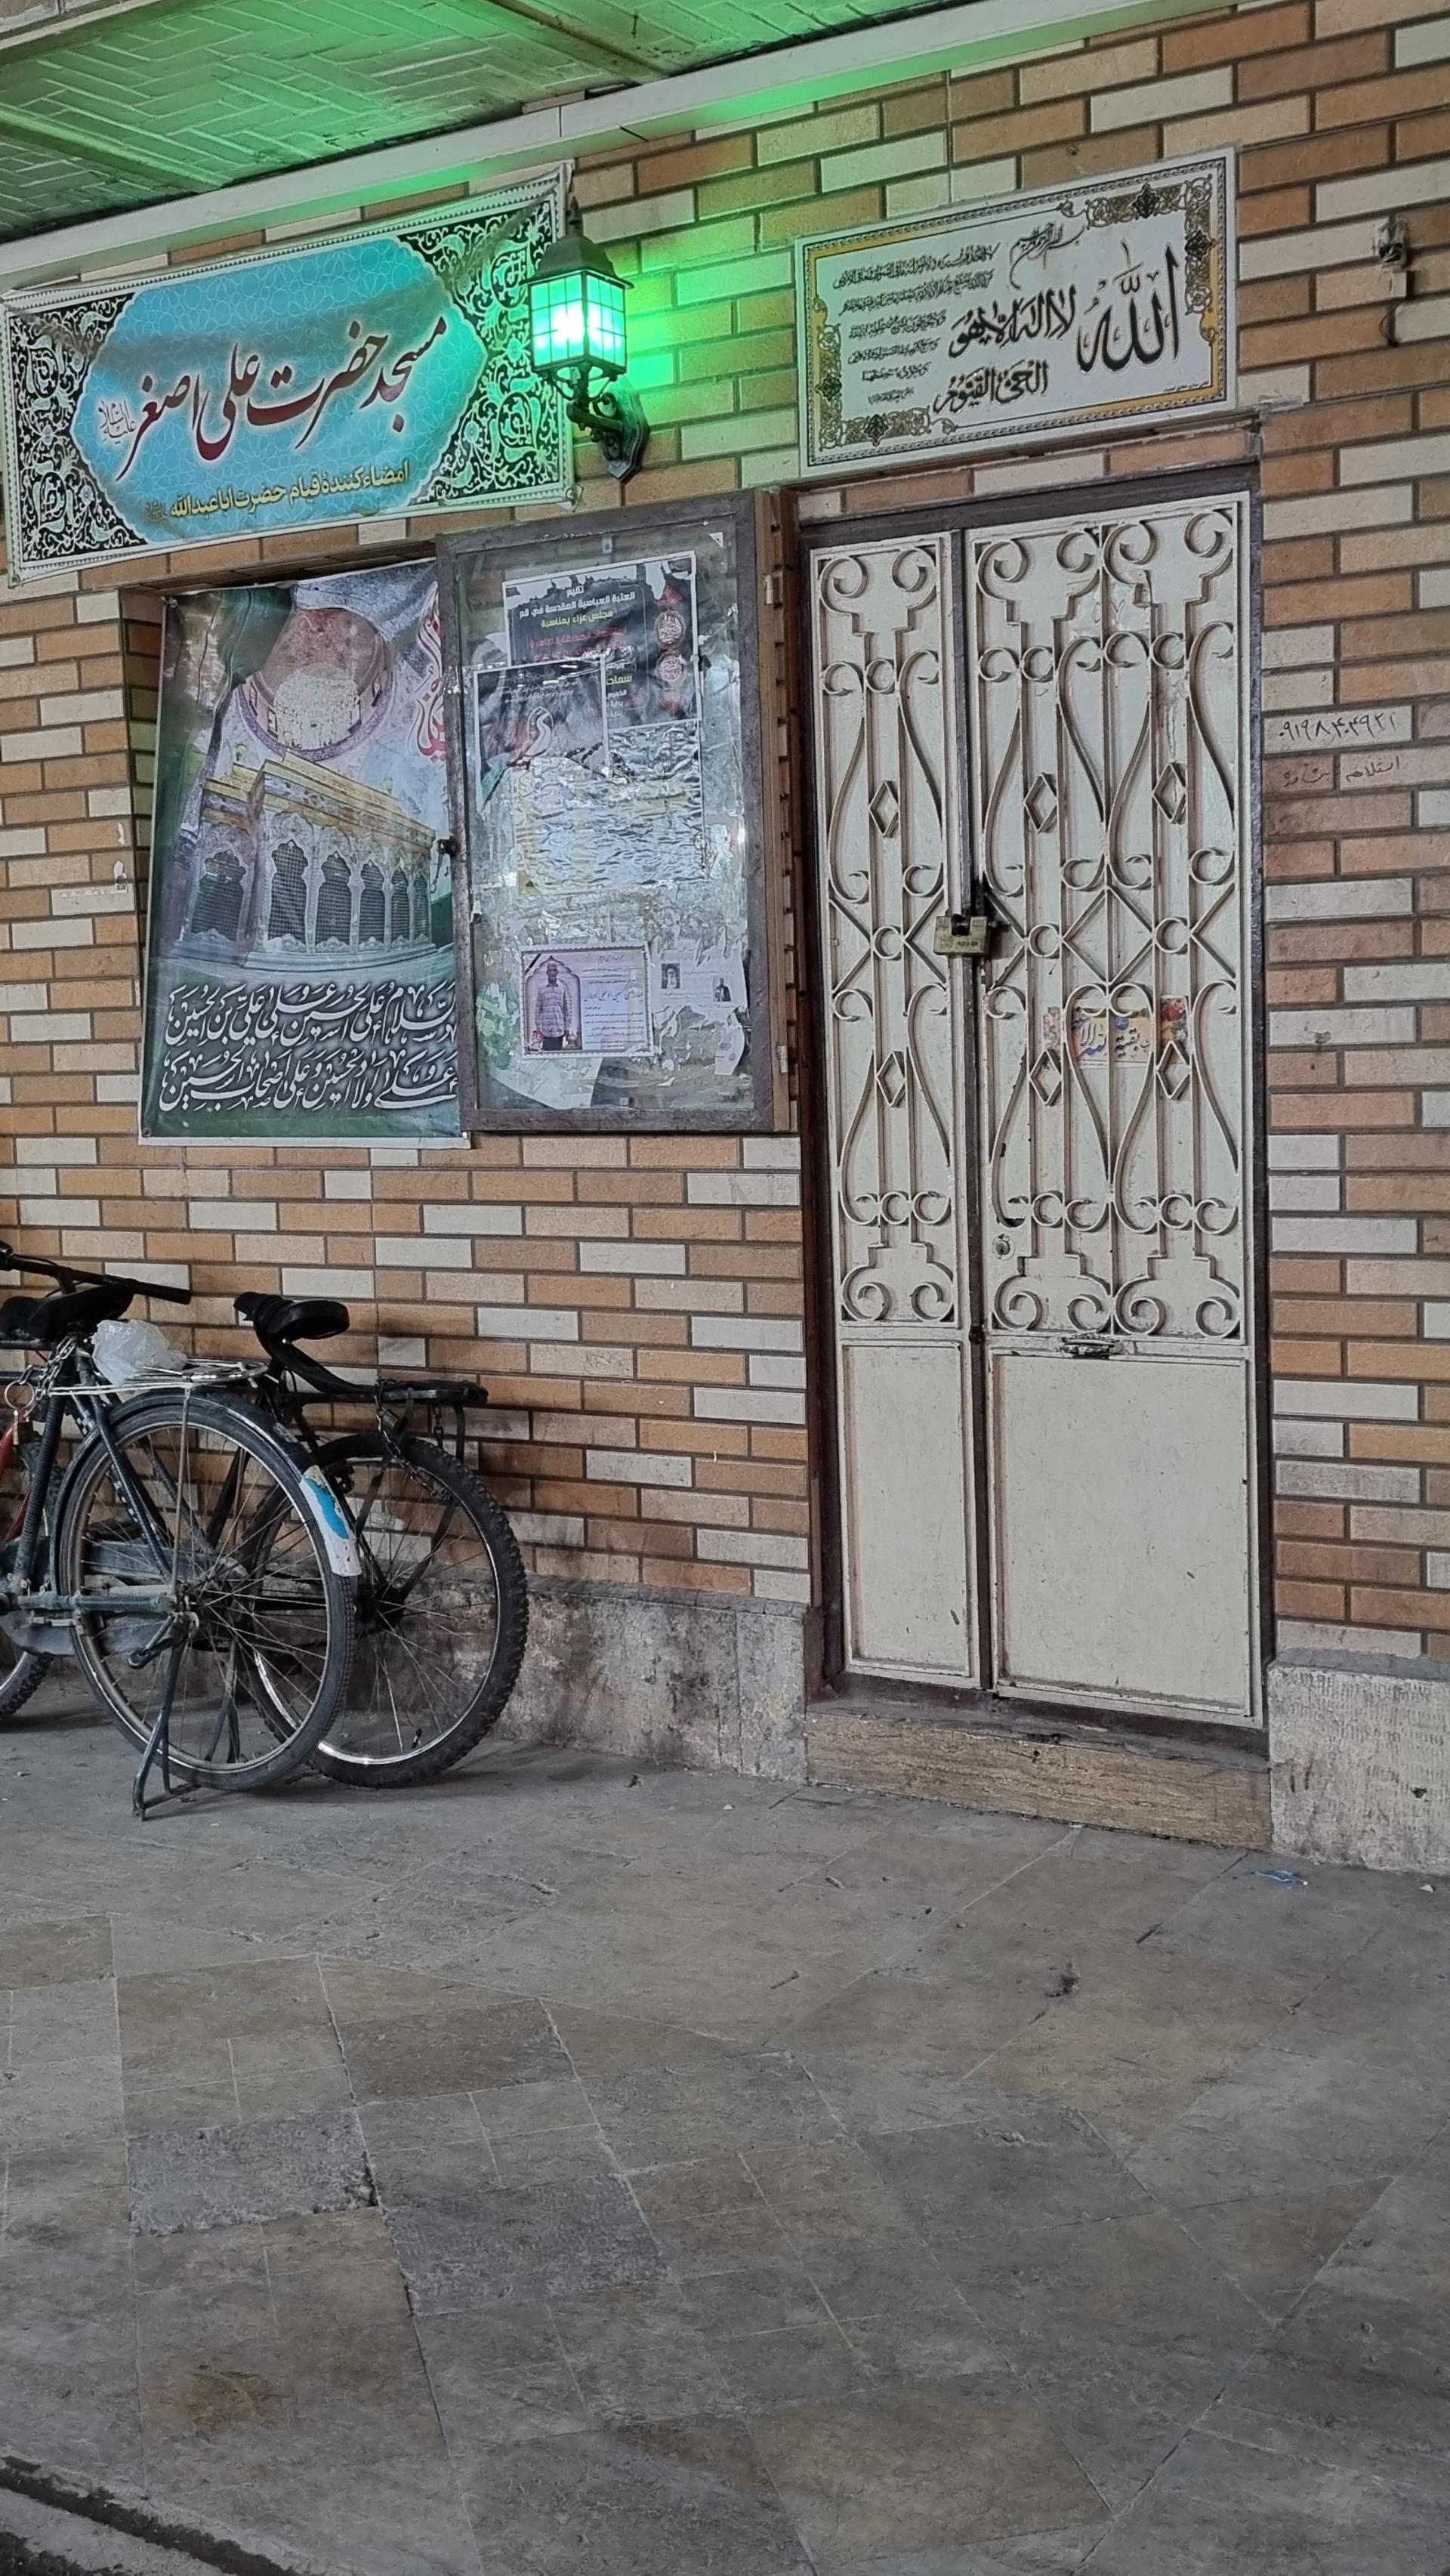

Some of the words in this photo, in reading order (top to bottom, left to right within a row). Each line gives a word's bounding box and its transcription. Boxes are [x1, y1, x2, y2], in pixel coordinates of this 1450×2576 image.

[196, 342, 261, 462] علی
[245, 320, 390, 449] حضرت
[361, 317, 446, 433] مسجد
[117, 373, 201, 480] اصغر
[235, 485, 285, 513] حضرت
[289, 471, 321, 505] قیام
[589, 610, 613, 622] مجلس
[381, 982, 457, 1043] لسلام
